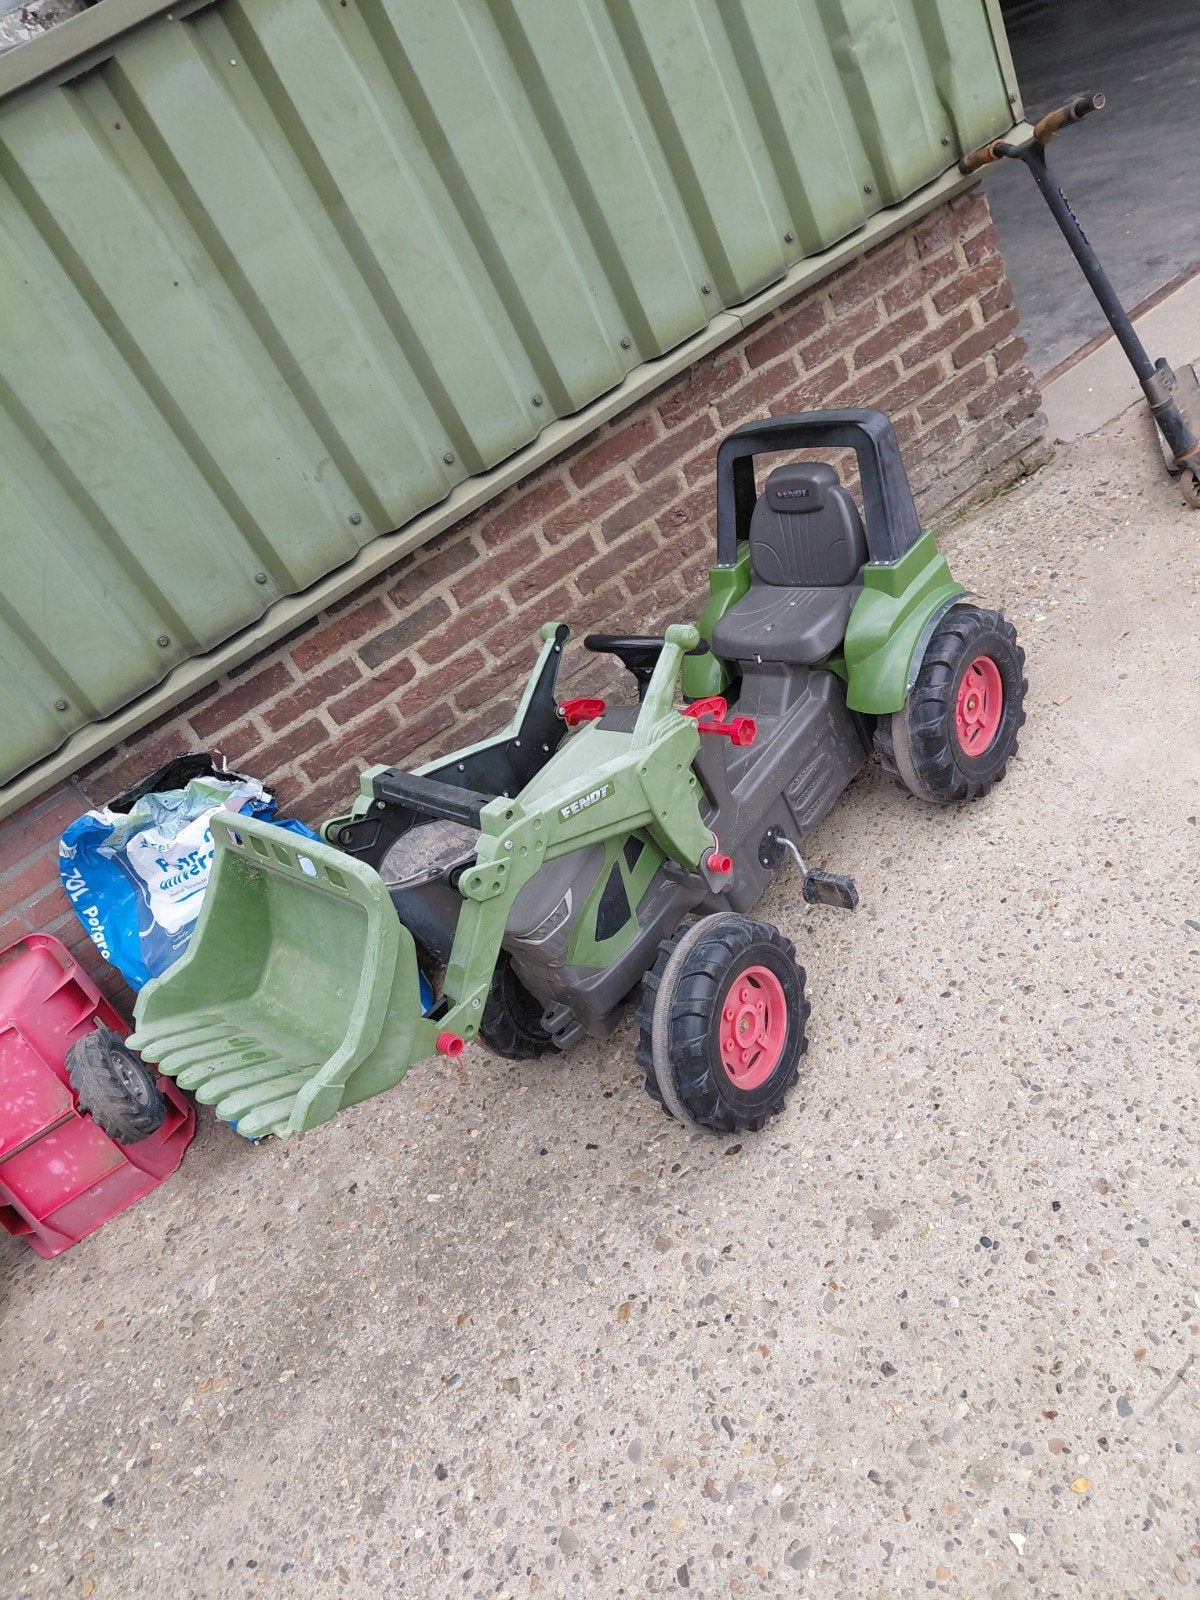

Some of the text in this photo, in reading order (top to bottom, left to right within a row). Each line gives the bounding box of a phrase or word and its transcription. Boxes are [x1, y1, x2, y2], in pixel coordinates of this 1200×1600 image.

[560, 784, 610, 819] FENDT
[60, 868, 90, 902] 70L
[82, 905, 110, 960] Potgro
